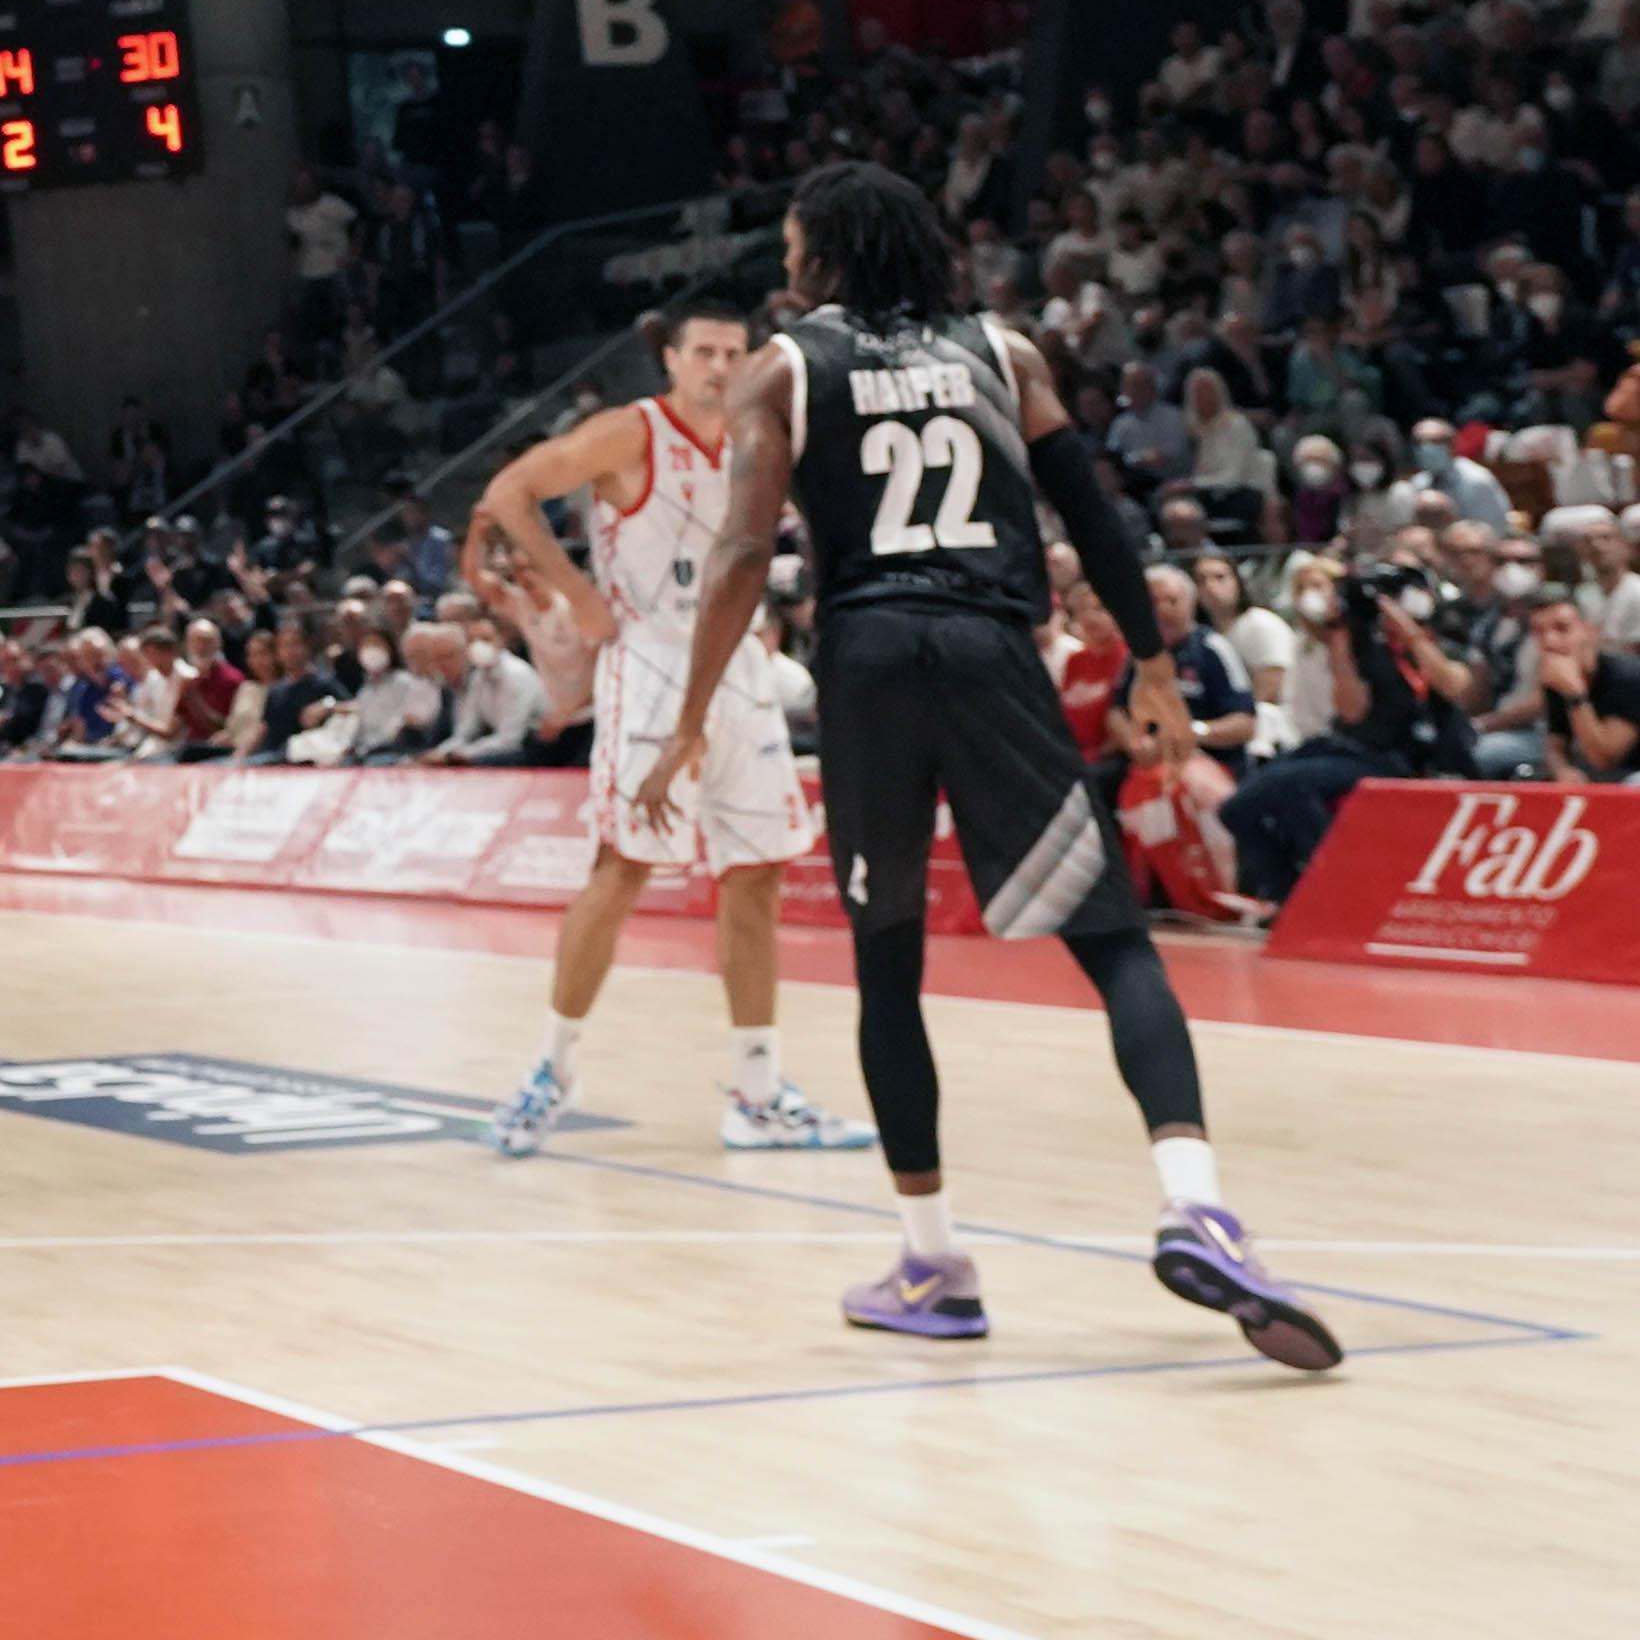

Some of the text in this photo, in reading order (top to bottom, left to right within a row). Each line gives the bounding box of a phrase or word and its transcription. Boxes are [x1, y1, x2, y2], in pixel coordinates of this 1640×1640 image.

[117, 30, 180, 83] 30
[0, 120, 37, 170] 2
[146, 103, 182, 152] 4
[861, 415, 998, 556] 22
[1406, 792, 1599, 901] Fab
